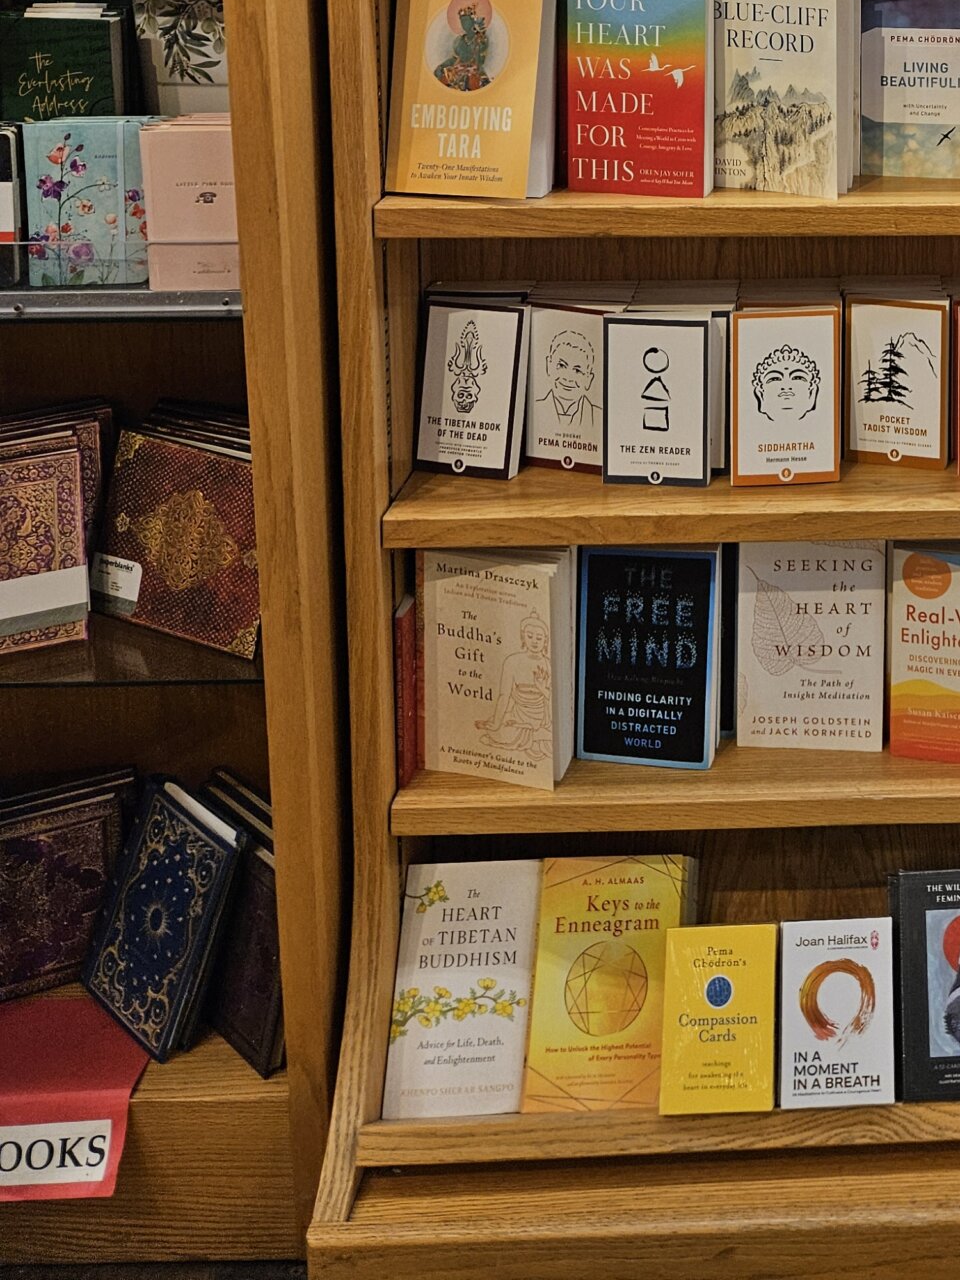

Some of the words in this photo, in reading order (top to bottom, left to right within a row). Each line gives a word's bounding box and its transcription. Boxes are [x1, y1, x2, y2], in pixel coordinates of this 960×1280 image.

[576, 22, 666, 47] HEART
[726, 29, 814, 53] RECORD
[903, 62, 948, 73] LIVING
[411, 104, 512, 132] EMBODYING
[577, 124, 626, 147] FOR
[438, 133, 481, 158] TARA
[573, 158, 634, 182] THIS
[639, 446, 655, 454] ZEN
[659, 446, 691, 456] READER
[758, 442, 815, 452] SIDDHARTHA
[774, 560, 873, 572] SEEKING
[796, 603, 872, 614] HEART
[437, 623, 502, 645] Buddha's
[775, 645, 872, 657] WISDOM
[447, 682, 493, 701] World
[598, 690, 642, 702] FINDING
[645, 694, 692, 706] CLARITY
[586, 895, 629, 913] Keys
[442, 906, 503, 922] HEART
[554, 916, 660, 938] Enneagram
[438, 928, 517, 946] TIBETAN
[796, 935, 824, 948] Joan
[828, 934, 868, 946] Halifax
[419, 951, 517, 969] BUDDHISM
[678, 1013, 757, 1031] Compassion
[794, 1062, 858, 1075] MOMENT
[825, 1074, 880, 1088] BREATH
